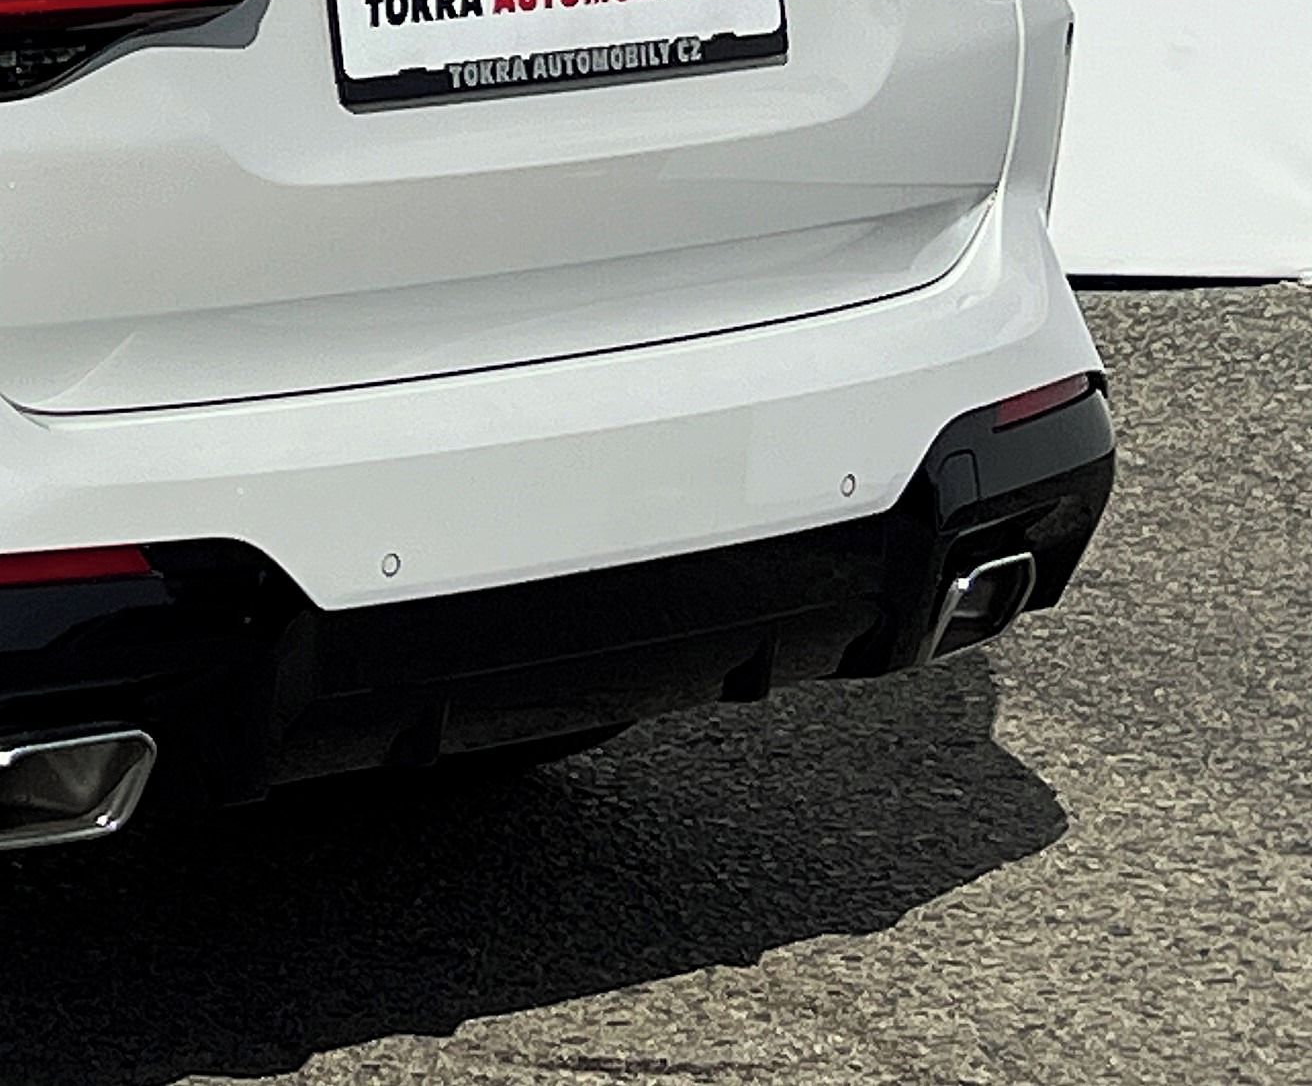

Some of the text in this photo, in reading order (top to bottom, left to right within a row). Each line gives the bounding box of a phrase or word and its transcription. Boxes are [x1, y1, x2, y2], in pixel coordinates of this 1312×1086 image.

[449, 38, 703, 89] TOKRA AUTOMOBILY CZ
